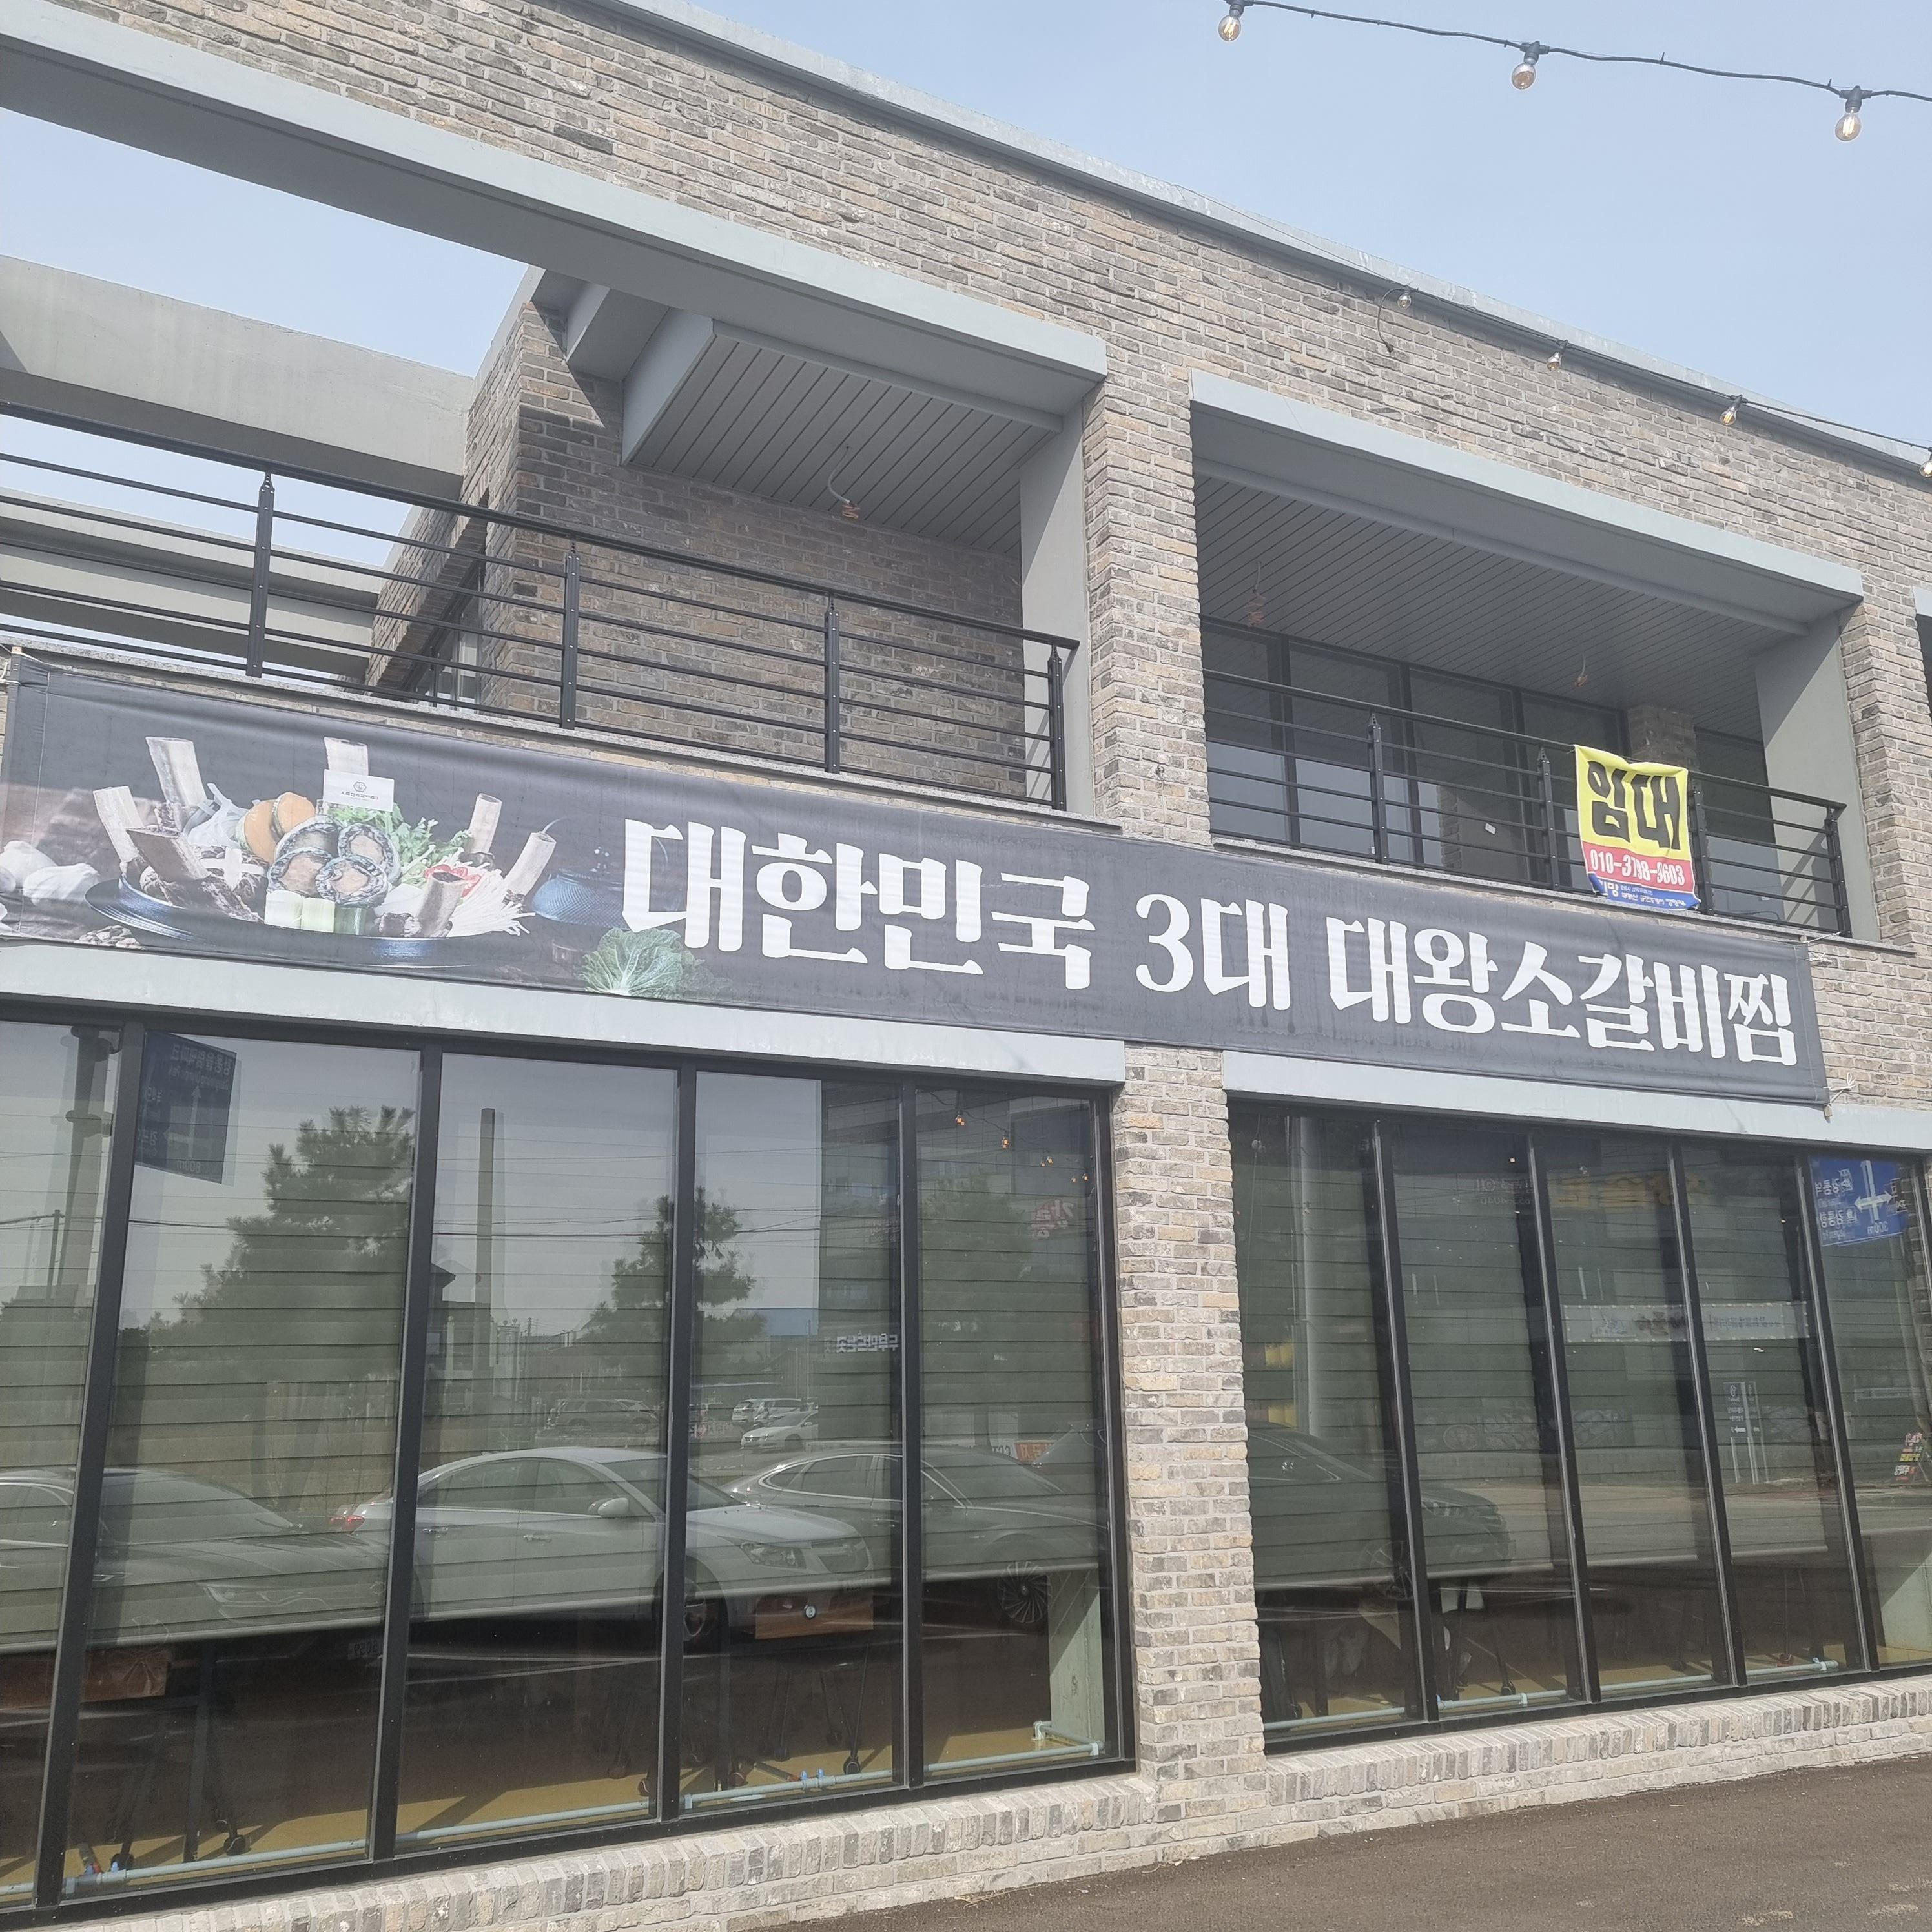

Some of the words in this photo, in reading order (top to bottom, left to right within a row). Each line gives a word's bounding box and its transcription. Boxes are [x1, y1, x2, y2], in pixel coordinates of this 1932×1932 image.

[1587, 760, 1681, 851] 임대
[622, 818, 1096, 990] 대한민국
[1135, 893, 1291, 1011] 3대
[1326, 916, 1798, 1066] 대왕소갈비찜
